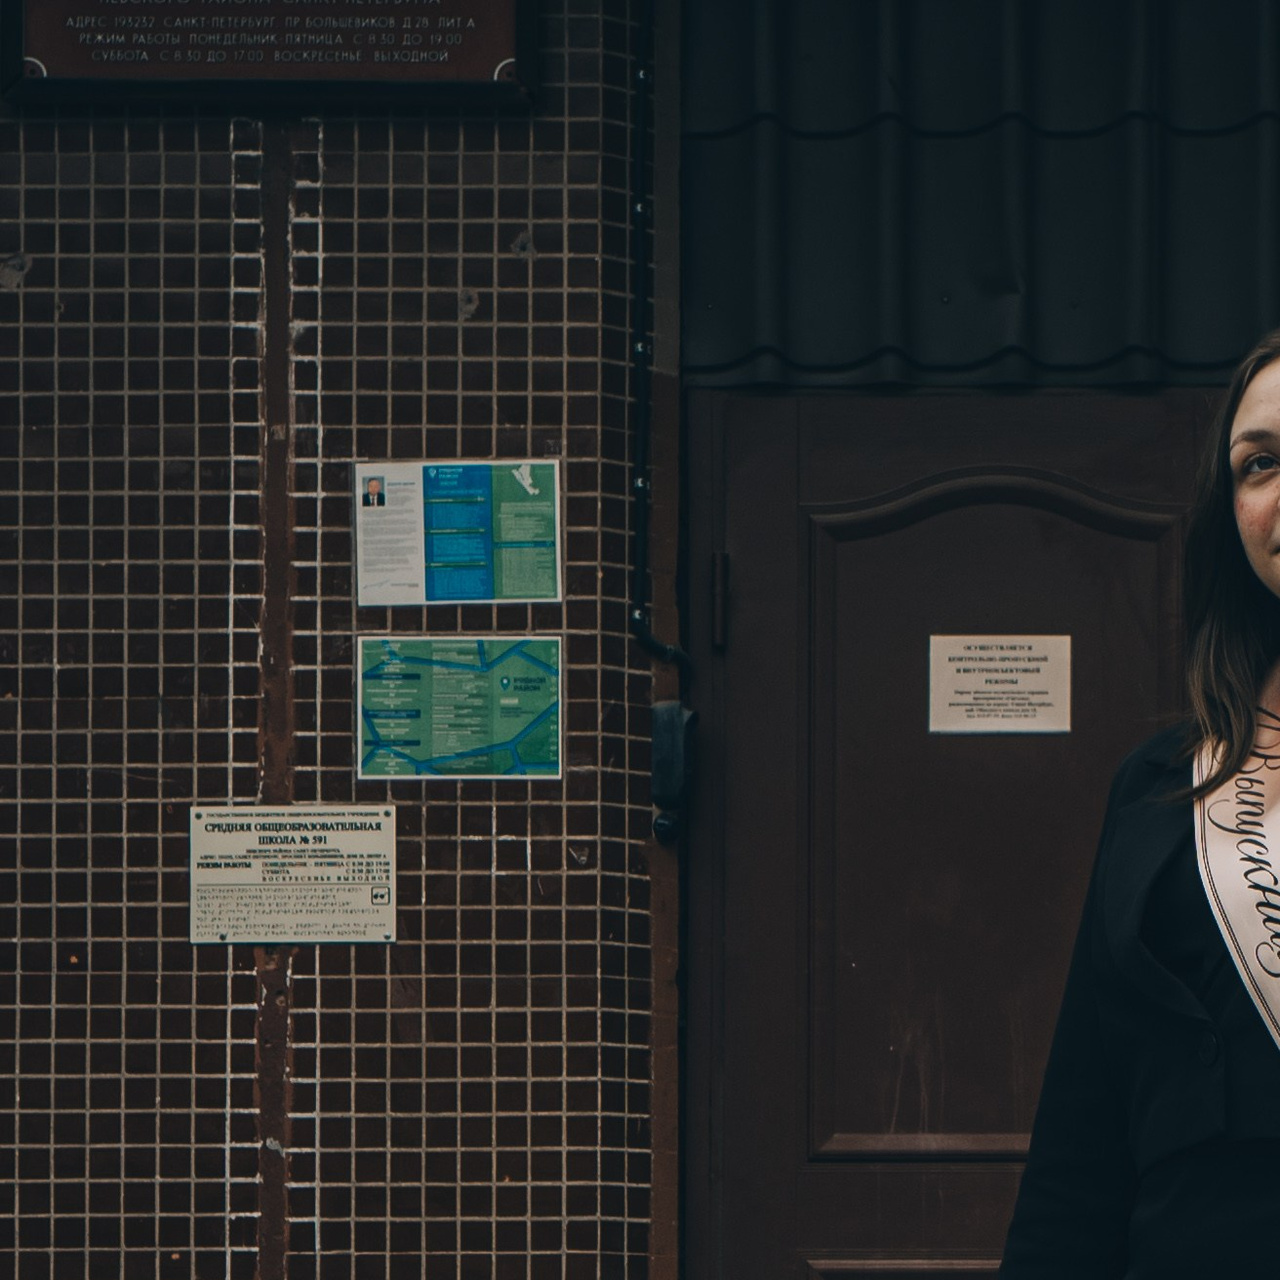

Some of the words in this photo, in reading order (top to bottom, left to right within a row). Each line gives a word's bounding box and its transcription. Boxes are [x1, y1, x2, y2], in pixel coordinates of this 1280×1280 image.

[79, 32, 126, 45] РЕЖИМ
[402, 33, 423, 46] ДО
[92, 49, 149, 63] СУББОТА
[205, 50, 227, 64] ДО
[374, 48, 449, 63] ВЫХОДНОЙ
[204, 822, 252, 833] СРЕДНЯЯ
[254, 821, 382, 833] ОБЩЕОБРАЗОВАТЕЛЬНАЯ
[258, 836, 296, 845] ШКОЛА
[299, 835, 310, 845] №
[312, 835, 328, 845] 591
